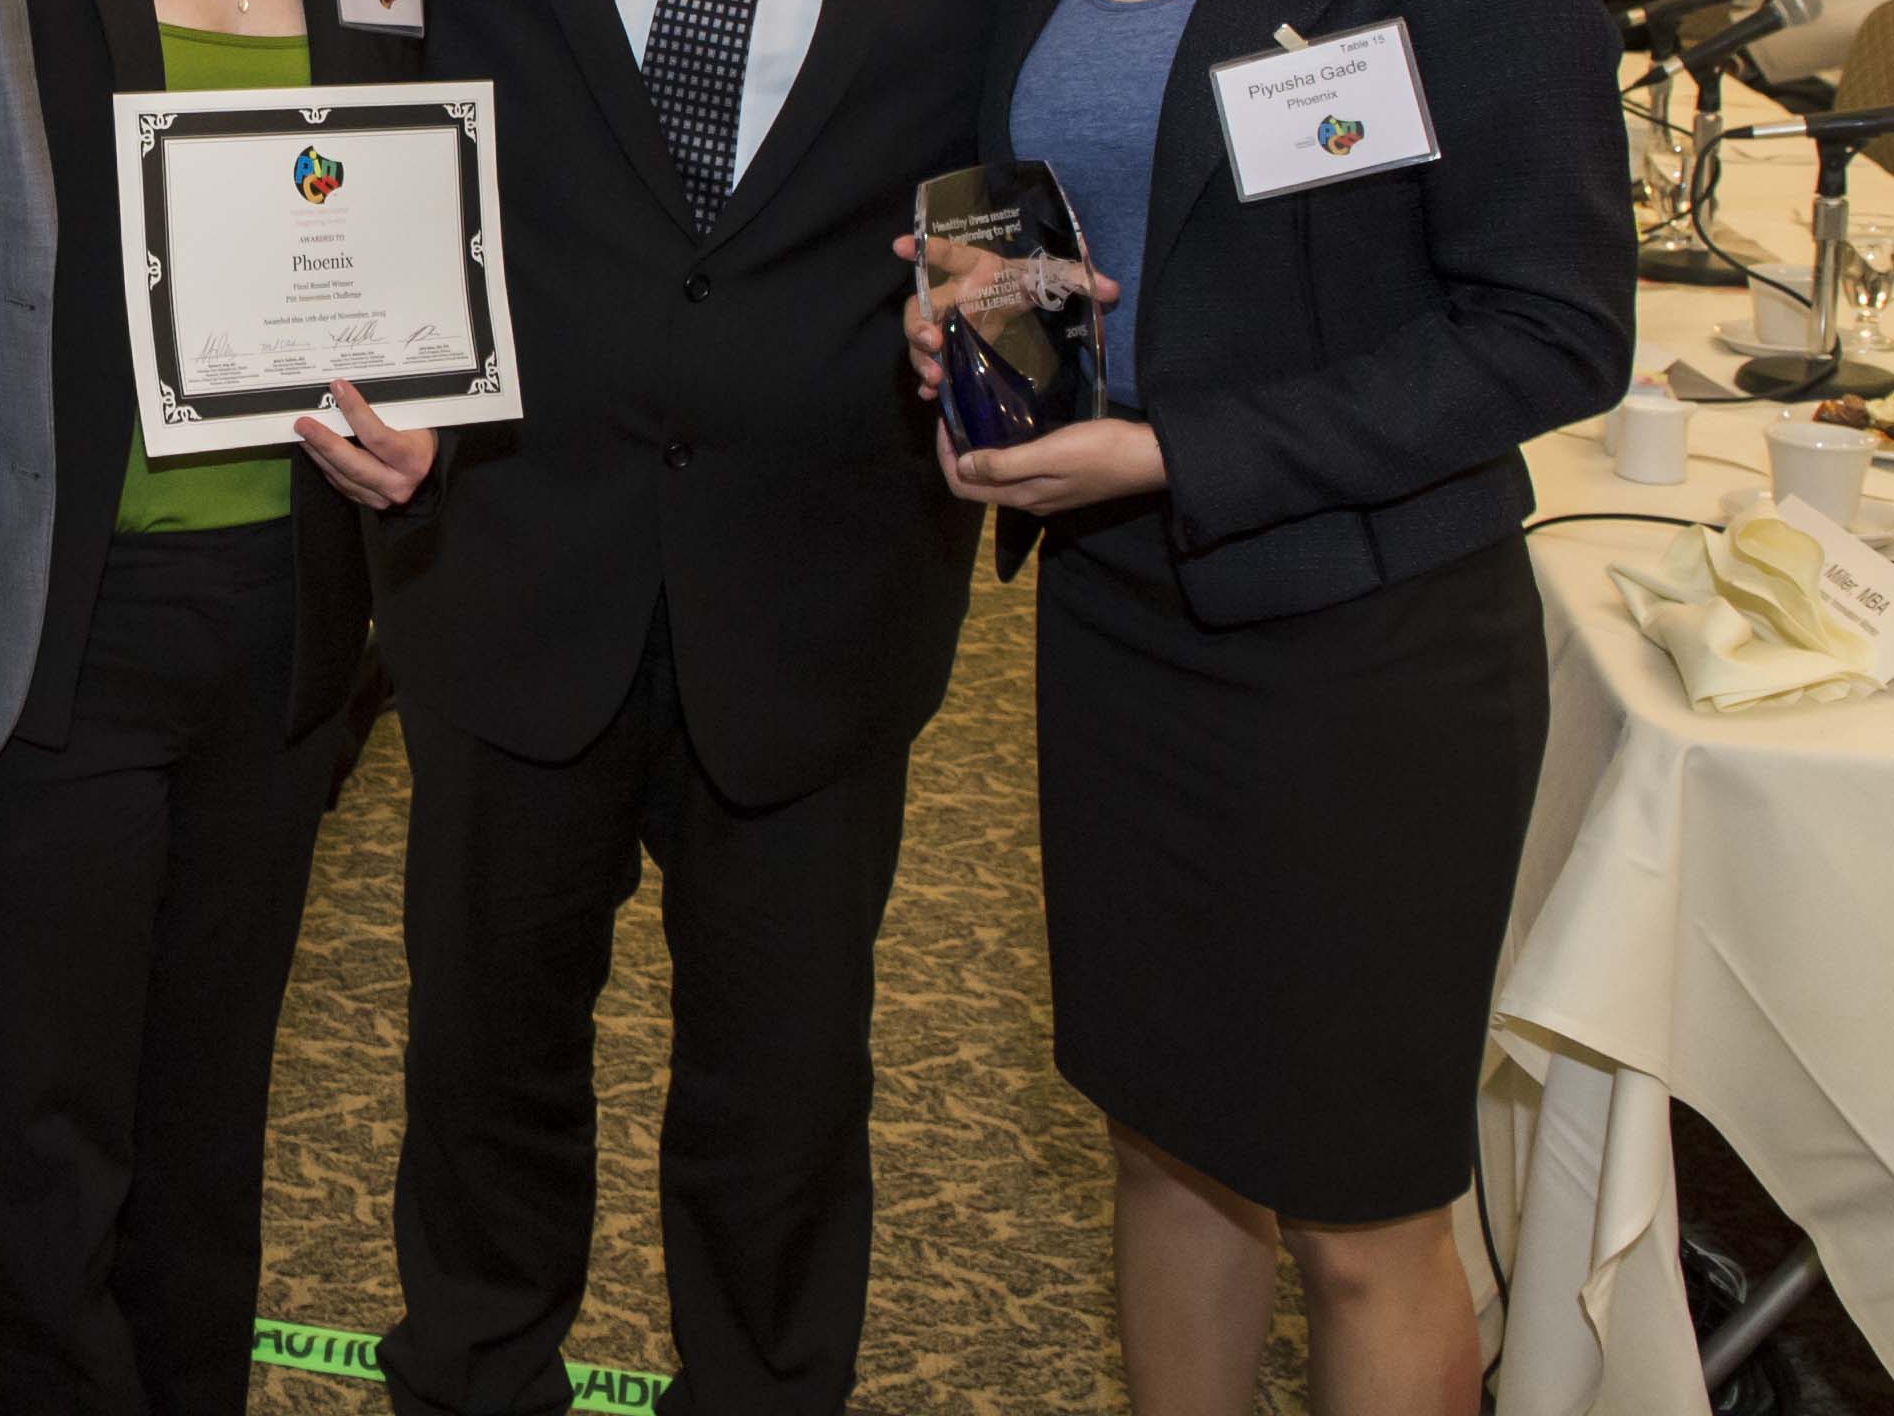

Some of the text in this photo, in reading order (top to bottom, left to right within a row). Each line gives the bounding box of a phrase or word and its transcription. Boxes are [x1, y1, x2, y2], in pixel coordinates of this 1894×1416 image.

[1339, 33, 1385, 55] Table 15
[1248, 58, 1369, 101] Piyusha Gade
[1286, 88, 1339, 110] Phoenix
[932, 217, 967, 233] Healthy
[993, 226, 1004, 235] to
[335, 234, 345, 242] TO
[292, 252, 354, 272] Phoenix
[1066, 325, 1089, 338] 2015
[1856, 587, 1891, 616] MBA
